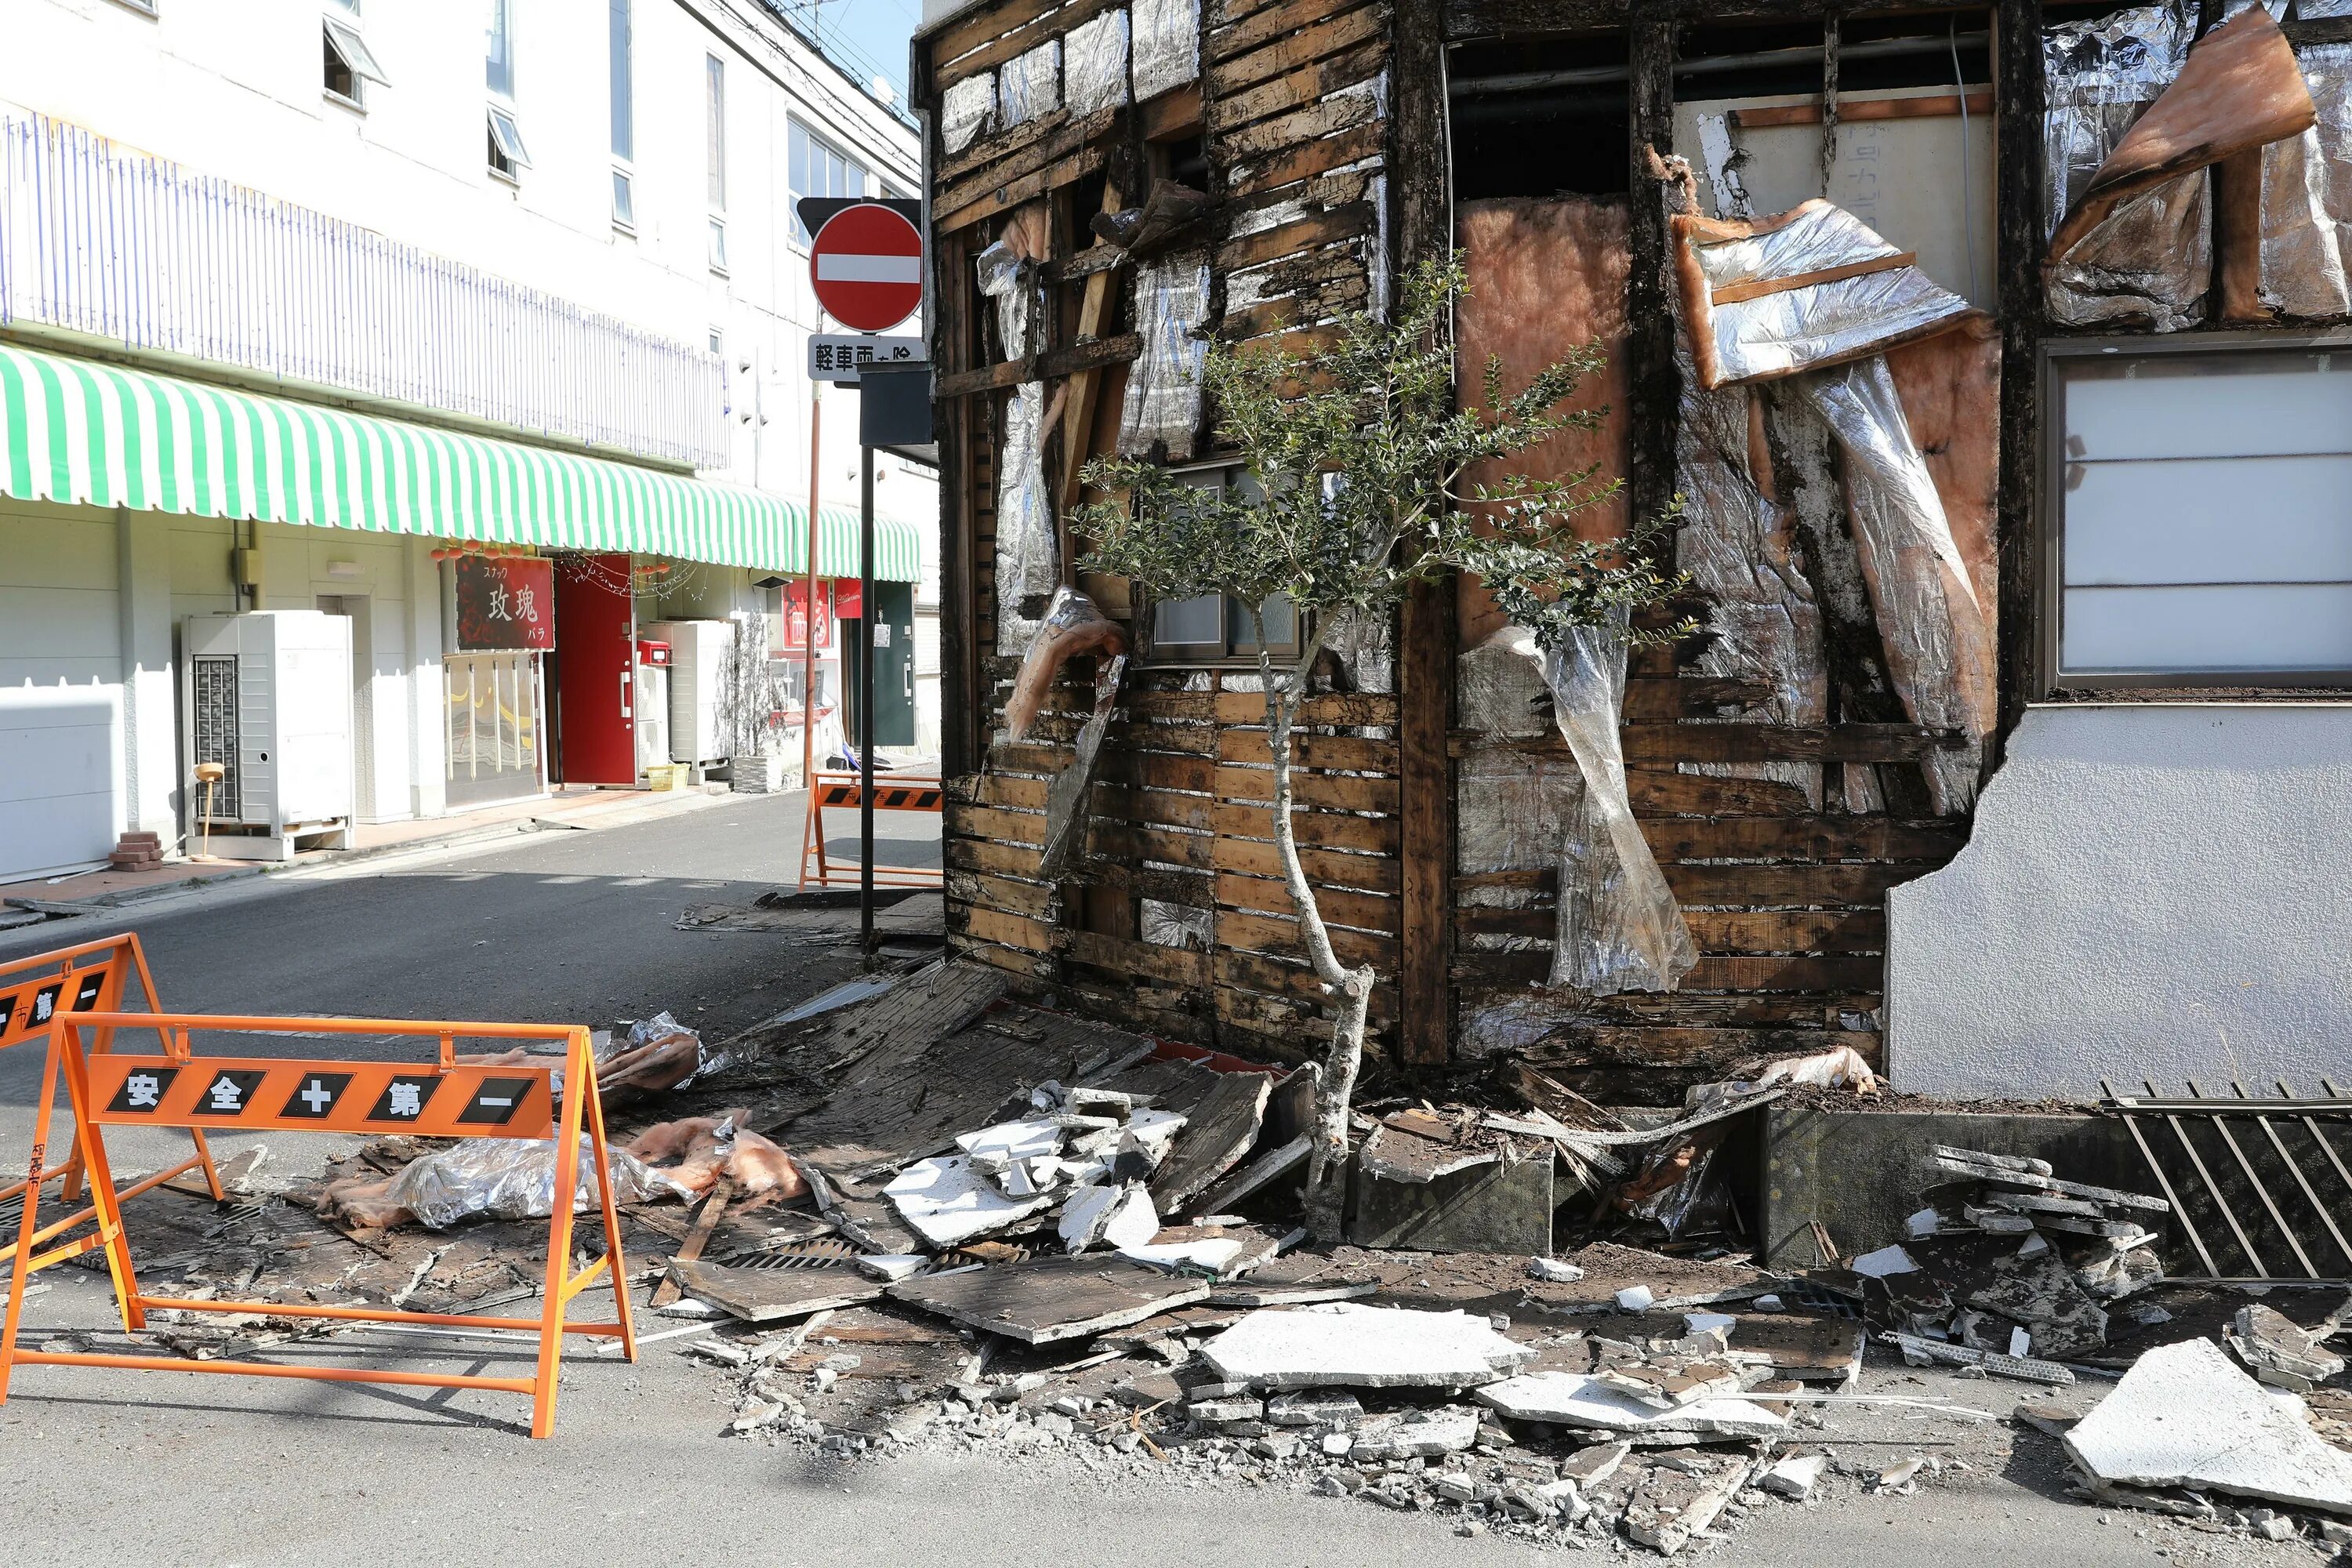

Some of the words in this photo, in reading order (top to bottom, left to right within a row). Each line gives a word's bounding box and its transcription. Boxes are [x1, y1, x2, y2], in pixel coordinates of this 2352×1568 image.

[484, 567, 508, 579] スナック
[488, 583, 539, 622] 玫瑰
[527, 627, 545, 641] バラ
